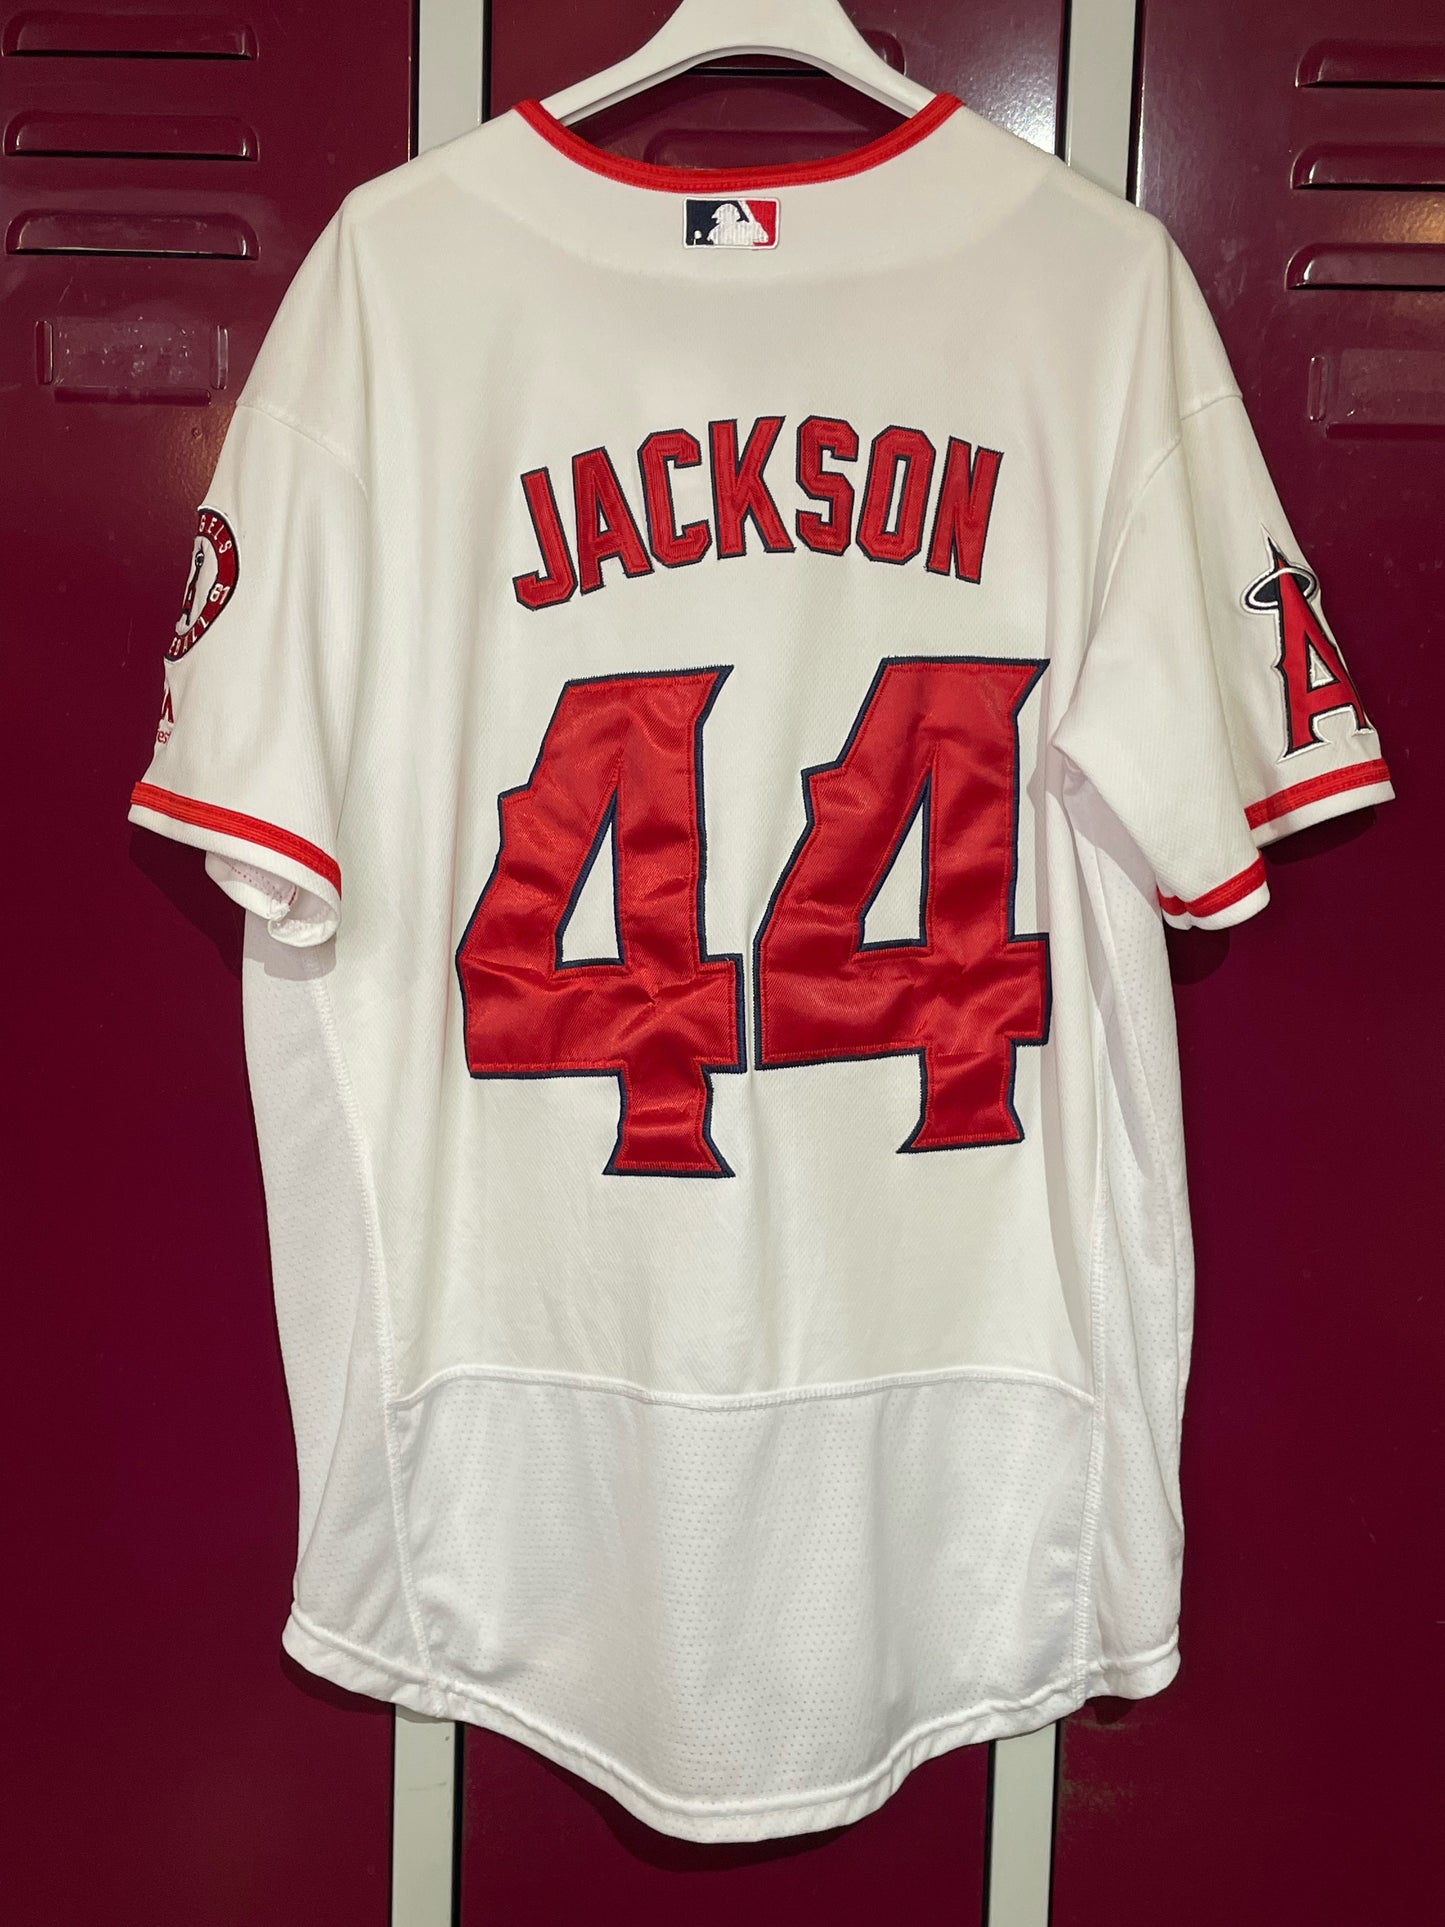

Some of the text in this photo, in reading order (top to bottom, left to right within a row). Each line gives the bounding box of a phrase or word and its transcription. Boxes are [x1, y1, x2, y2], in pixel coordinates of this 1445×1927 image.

[209, 583, 231, 605] 61
[513, 415, 1004, 611] JACKSON
[1244, 536, 1372, 758] A
[455, 656, 1053, 1179] 44
